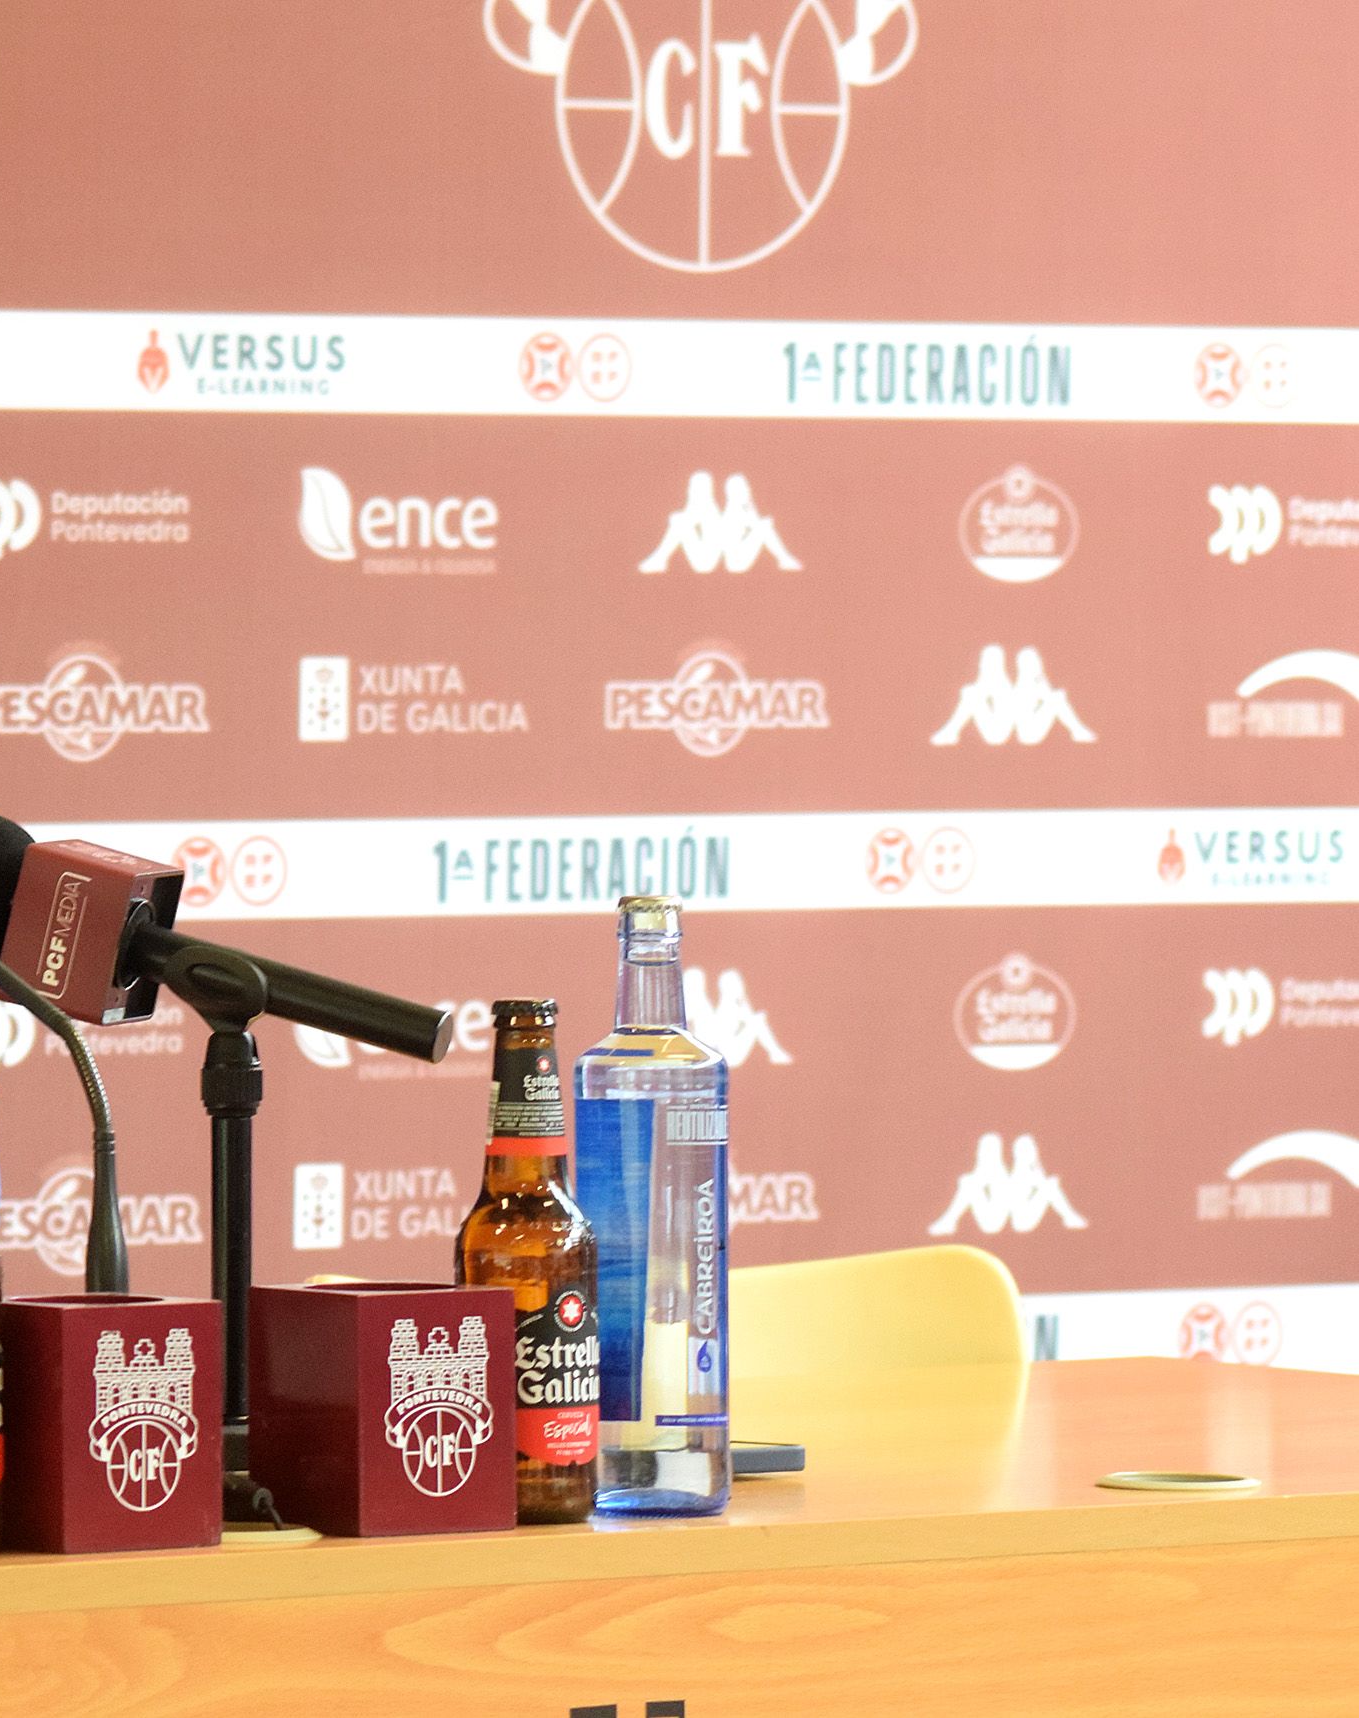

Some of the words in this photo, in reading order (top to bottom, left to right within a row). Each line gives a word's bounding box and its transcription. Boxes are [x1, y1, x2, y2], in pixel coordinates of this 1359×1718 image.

[178, 333, 346, 372] VERSUS
[197, 377, 329, 396] E-LEARNING
[833, 334, 1072, 406] FEDERACIÓN
[49, 490, 190, 519] Deputación
[50, 519, 190, 543] Pontevedra
[358, 496, 499, 549] ence
[358, 664, 464, 696] XUNTA
[358, 702, 395, 735] DE
[405, 701, 529, 735] GALICIA
[603, 679, 831, 730] PESCAMAR
[1193, 829, 1344, 864] VERSUS
[486, 826, 731, 902] FEDERACIÓN
[353, 1167, 458, 1201] XUNTA
[350, 1205, 391, 1240] DE
[100, 1401, 190, 1430] PONTEVEDRA
[395, 1389, 483, 1417] PONTEVEDRA
[542, 1412, 592, 1439] Especial
